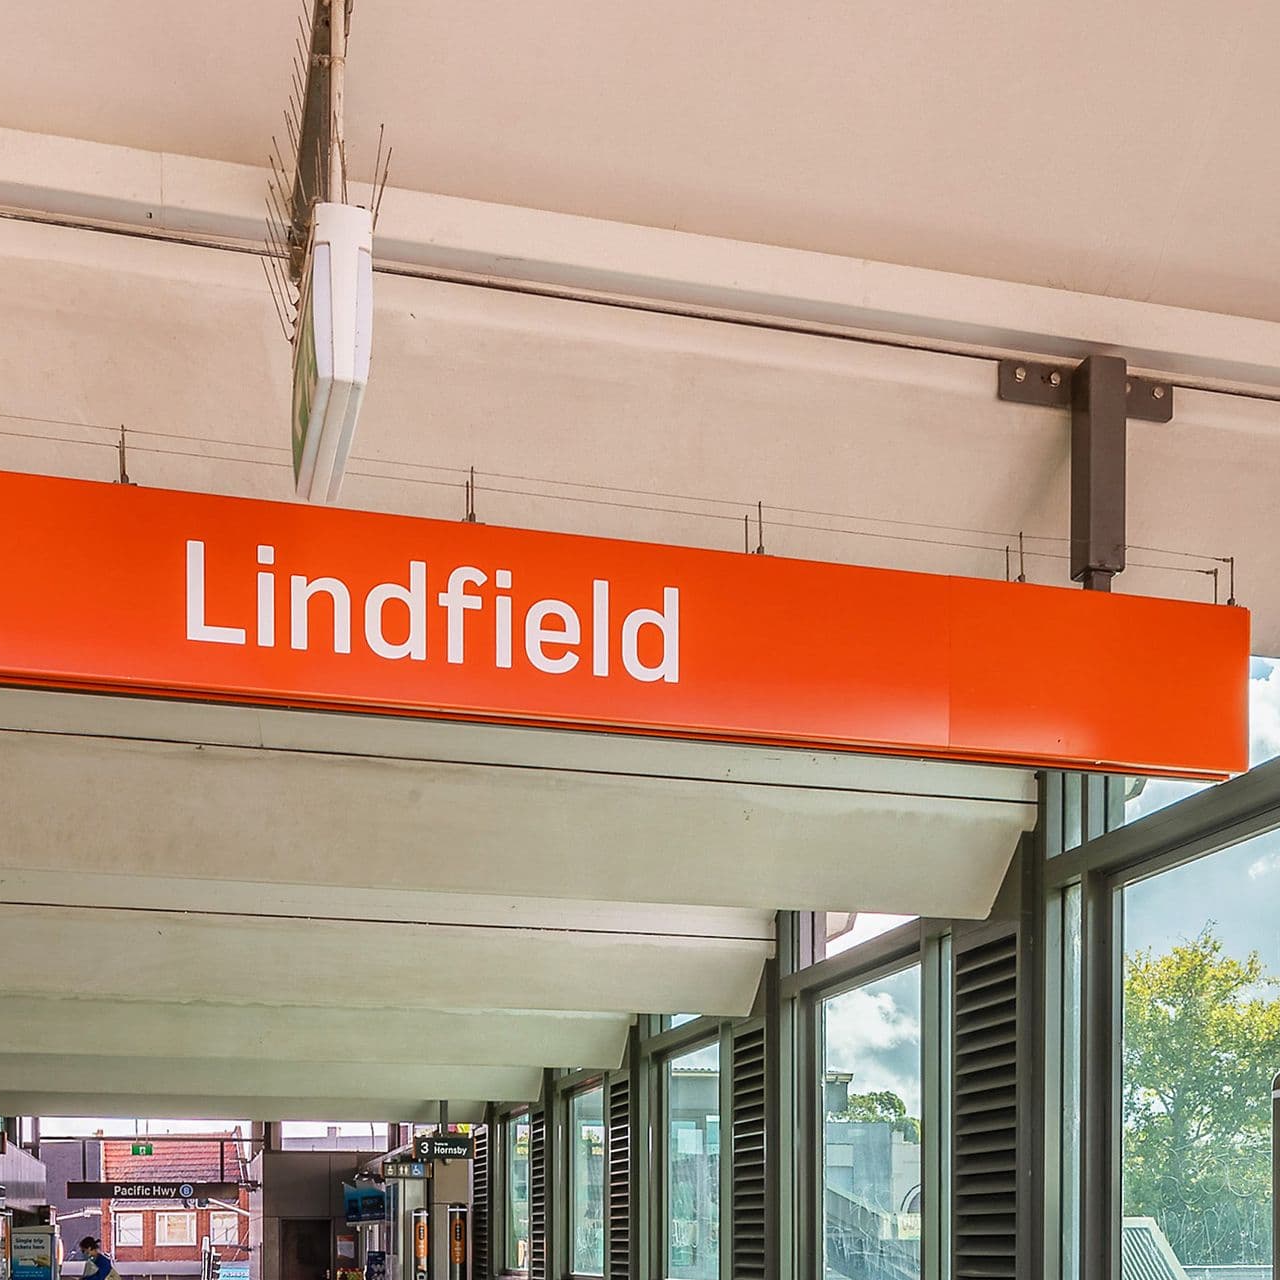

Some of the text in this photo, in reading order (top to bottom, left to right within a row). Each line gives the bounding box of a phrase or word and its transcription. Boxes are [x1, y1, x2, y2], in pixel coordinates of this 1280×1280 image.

[186, 539, 680, 684] Lindfield
[420, 1141, 429, 1154] 3
[434, 1146, 468, 1156] Hornsby
[113, 1185, 151, 1197] Pacific
[152, 1186, 177, 1198] Hwy
